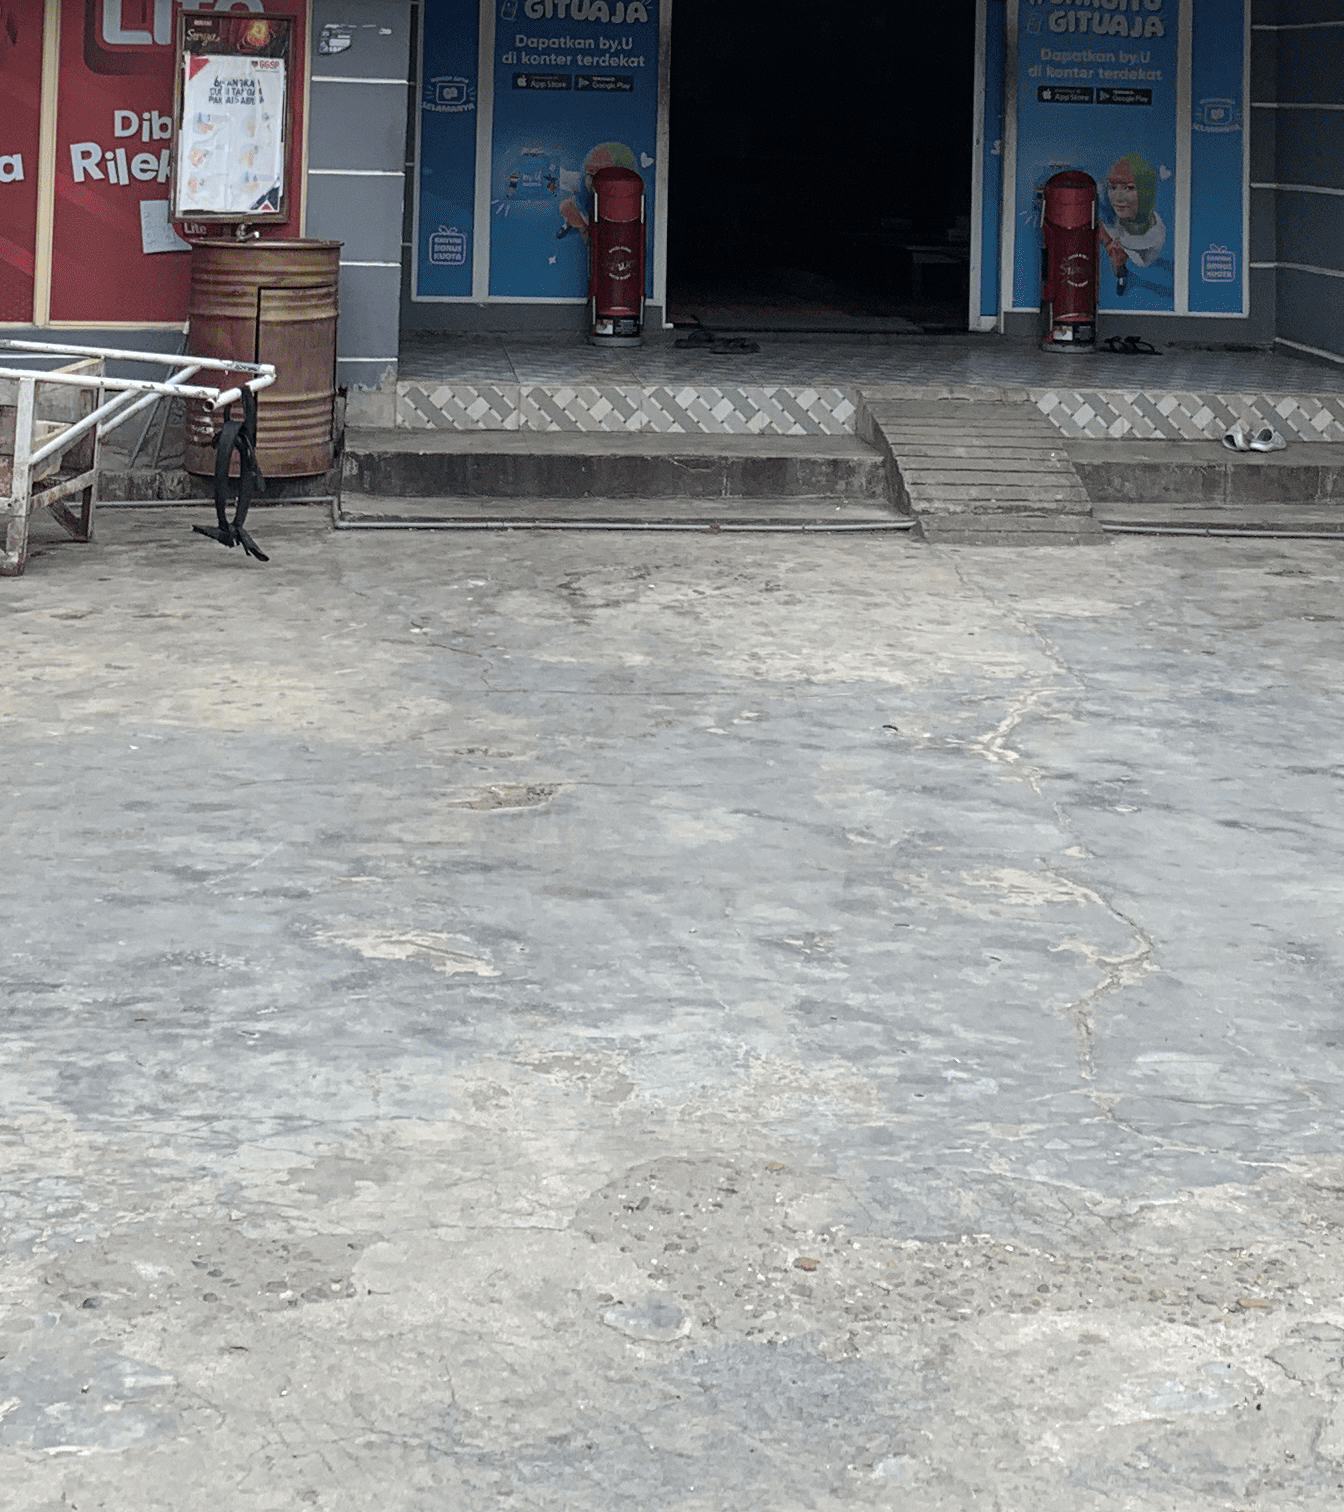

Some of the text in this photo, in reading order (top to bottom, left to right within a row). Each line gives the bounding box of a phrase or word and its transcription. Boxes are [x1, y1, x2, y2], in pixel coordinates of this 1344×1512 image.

[1048, 10, 1165, 38] GITUAJA
[515, 35, 633, 52] Dapatkan by.U
[502, 52, 646, 68] di konter terdekat
[1040, 48, 1115, 64] Dapatkan
[113, 110, 173, 143] Dib
[69, 142, 171, 186] Rile
